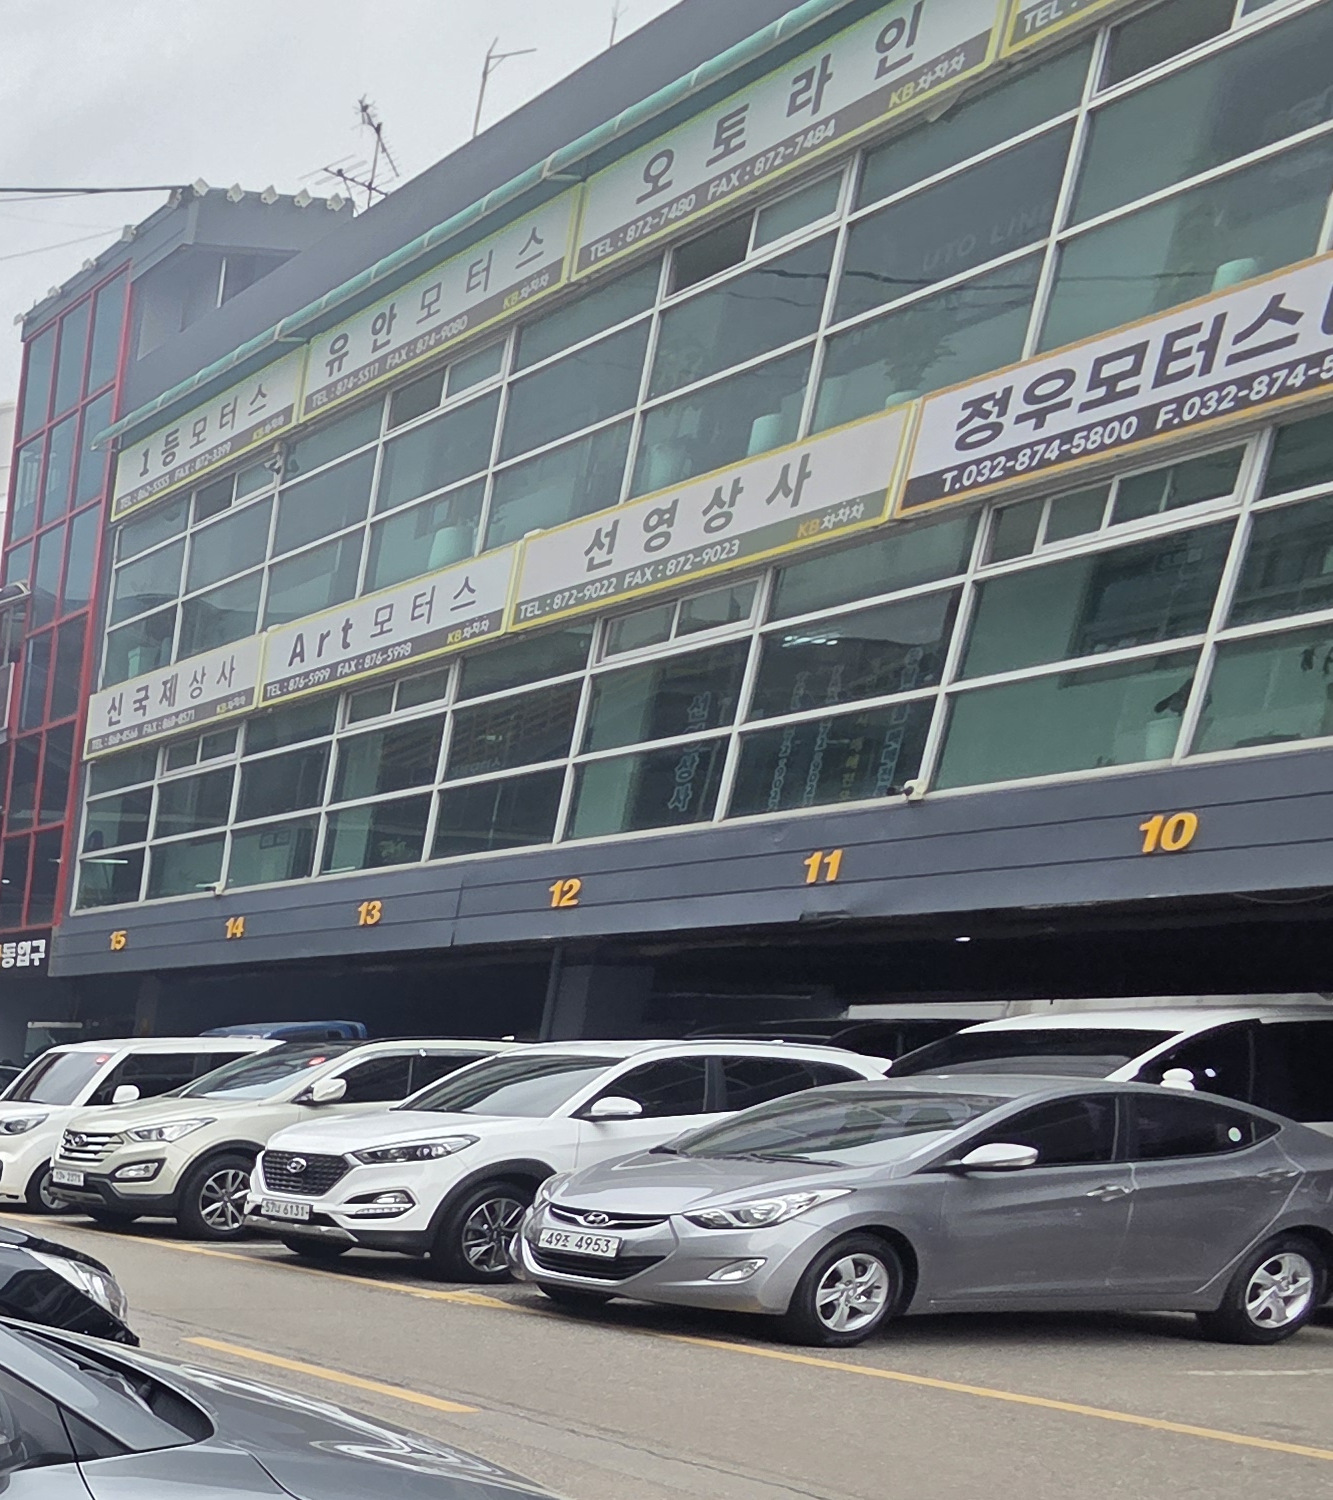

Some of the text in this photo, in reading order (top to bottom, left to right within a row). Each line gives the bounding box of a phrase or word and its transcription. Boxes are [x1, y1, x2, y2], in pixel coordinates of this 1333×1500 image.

[635, 1, 924, 205] 오토라인
[325, 227, 544, 377] 유안모터스
[955, 292, 1305, 452] 정우모터스
[584, 452, 812, 573] 선영상사
[107, 654, 236, 728] 신국제상사
[1138, 812, 1199, 854] 10
[803, 848, 843, 885] 11
[548, 878, 582, 909] 12
[225, 916, 245, 939] 14
[357, 901, 382, 926] 13
[109, 930, 128, 951] 15
[574, 1236, 612, 1254] 4953
